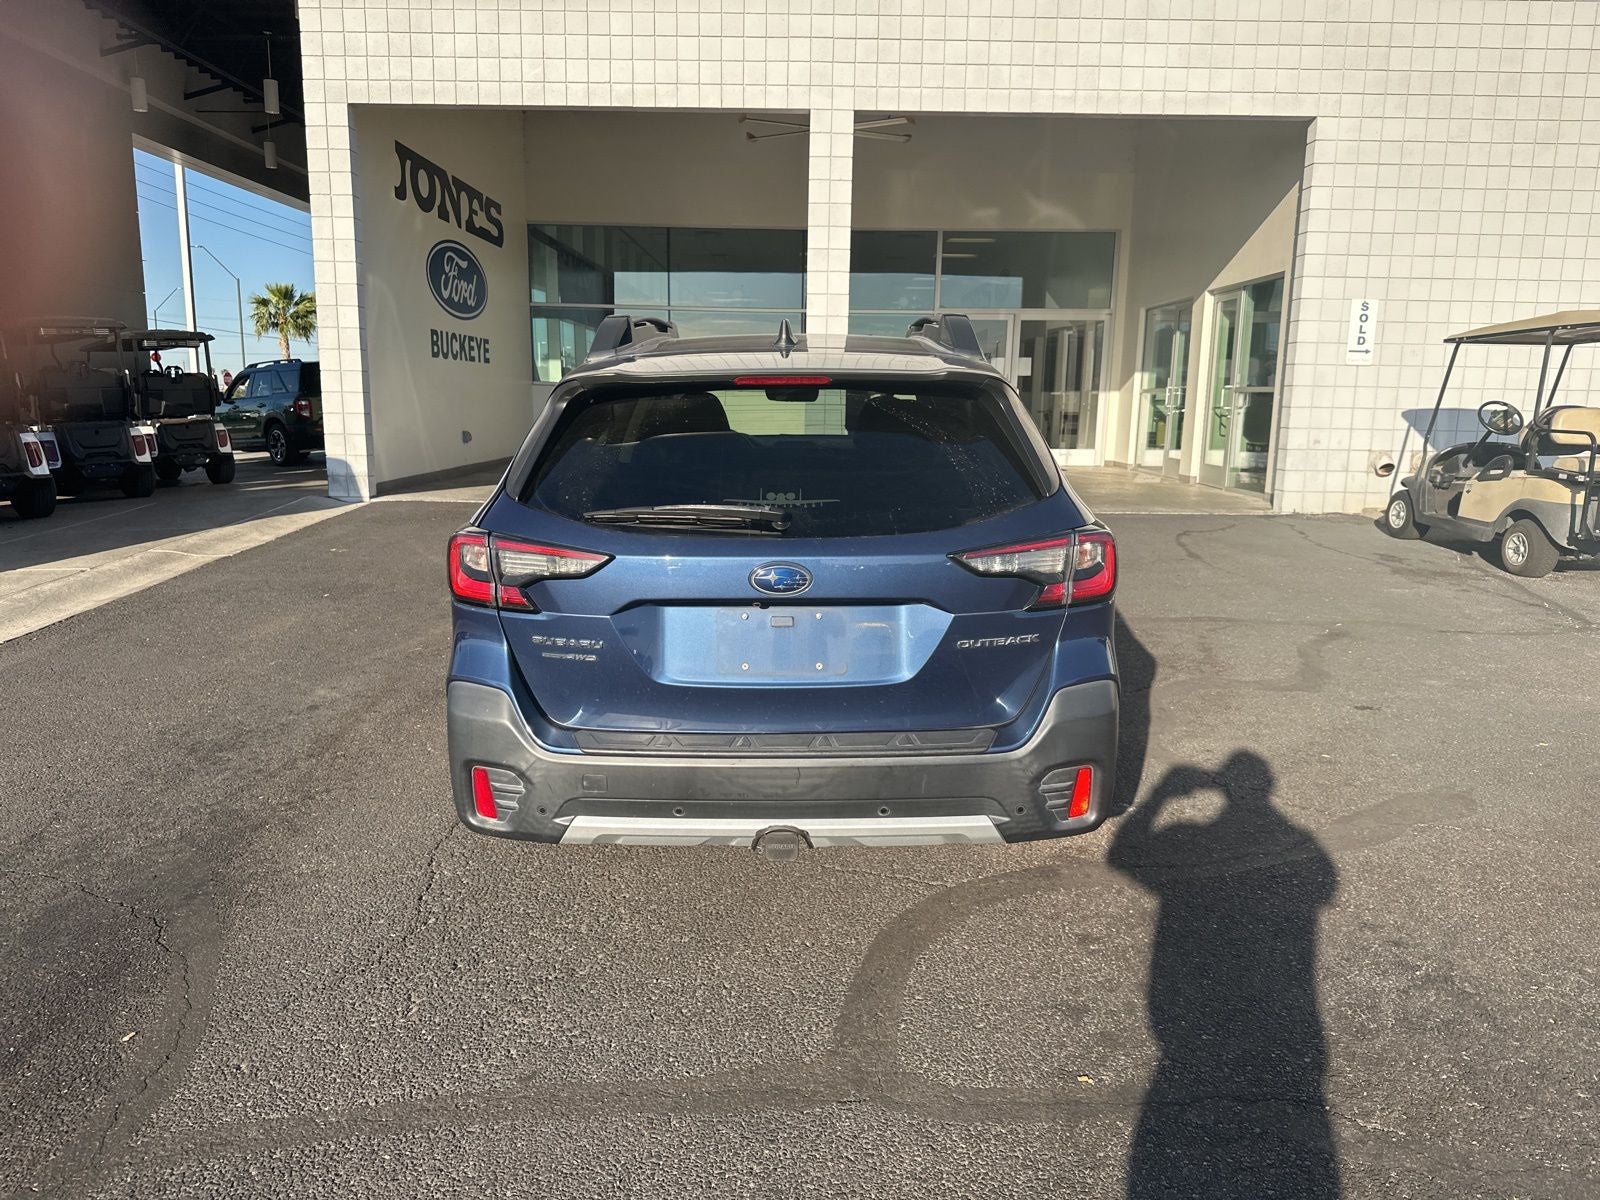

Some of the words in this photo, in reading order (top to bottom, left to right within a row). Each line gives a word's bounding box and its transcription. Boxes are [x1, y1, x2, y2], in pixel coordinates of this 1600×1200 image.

[394, 139, 504, 249] JONES
[441, 251, 478, 307] Ford
[430, 328, 491, 364] BUCKEYE
[1357, 301, 1370, 346] SOLD
[957, 633, 1040, 649] OUTBACK
